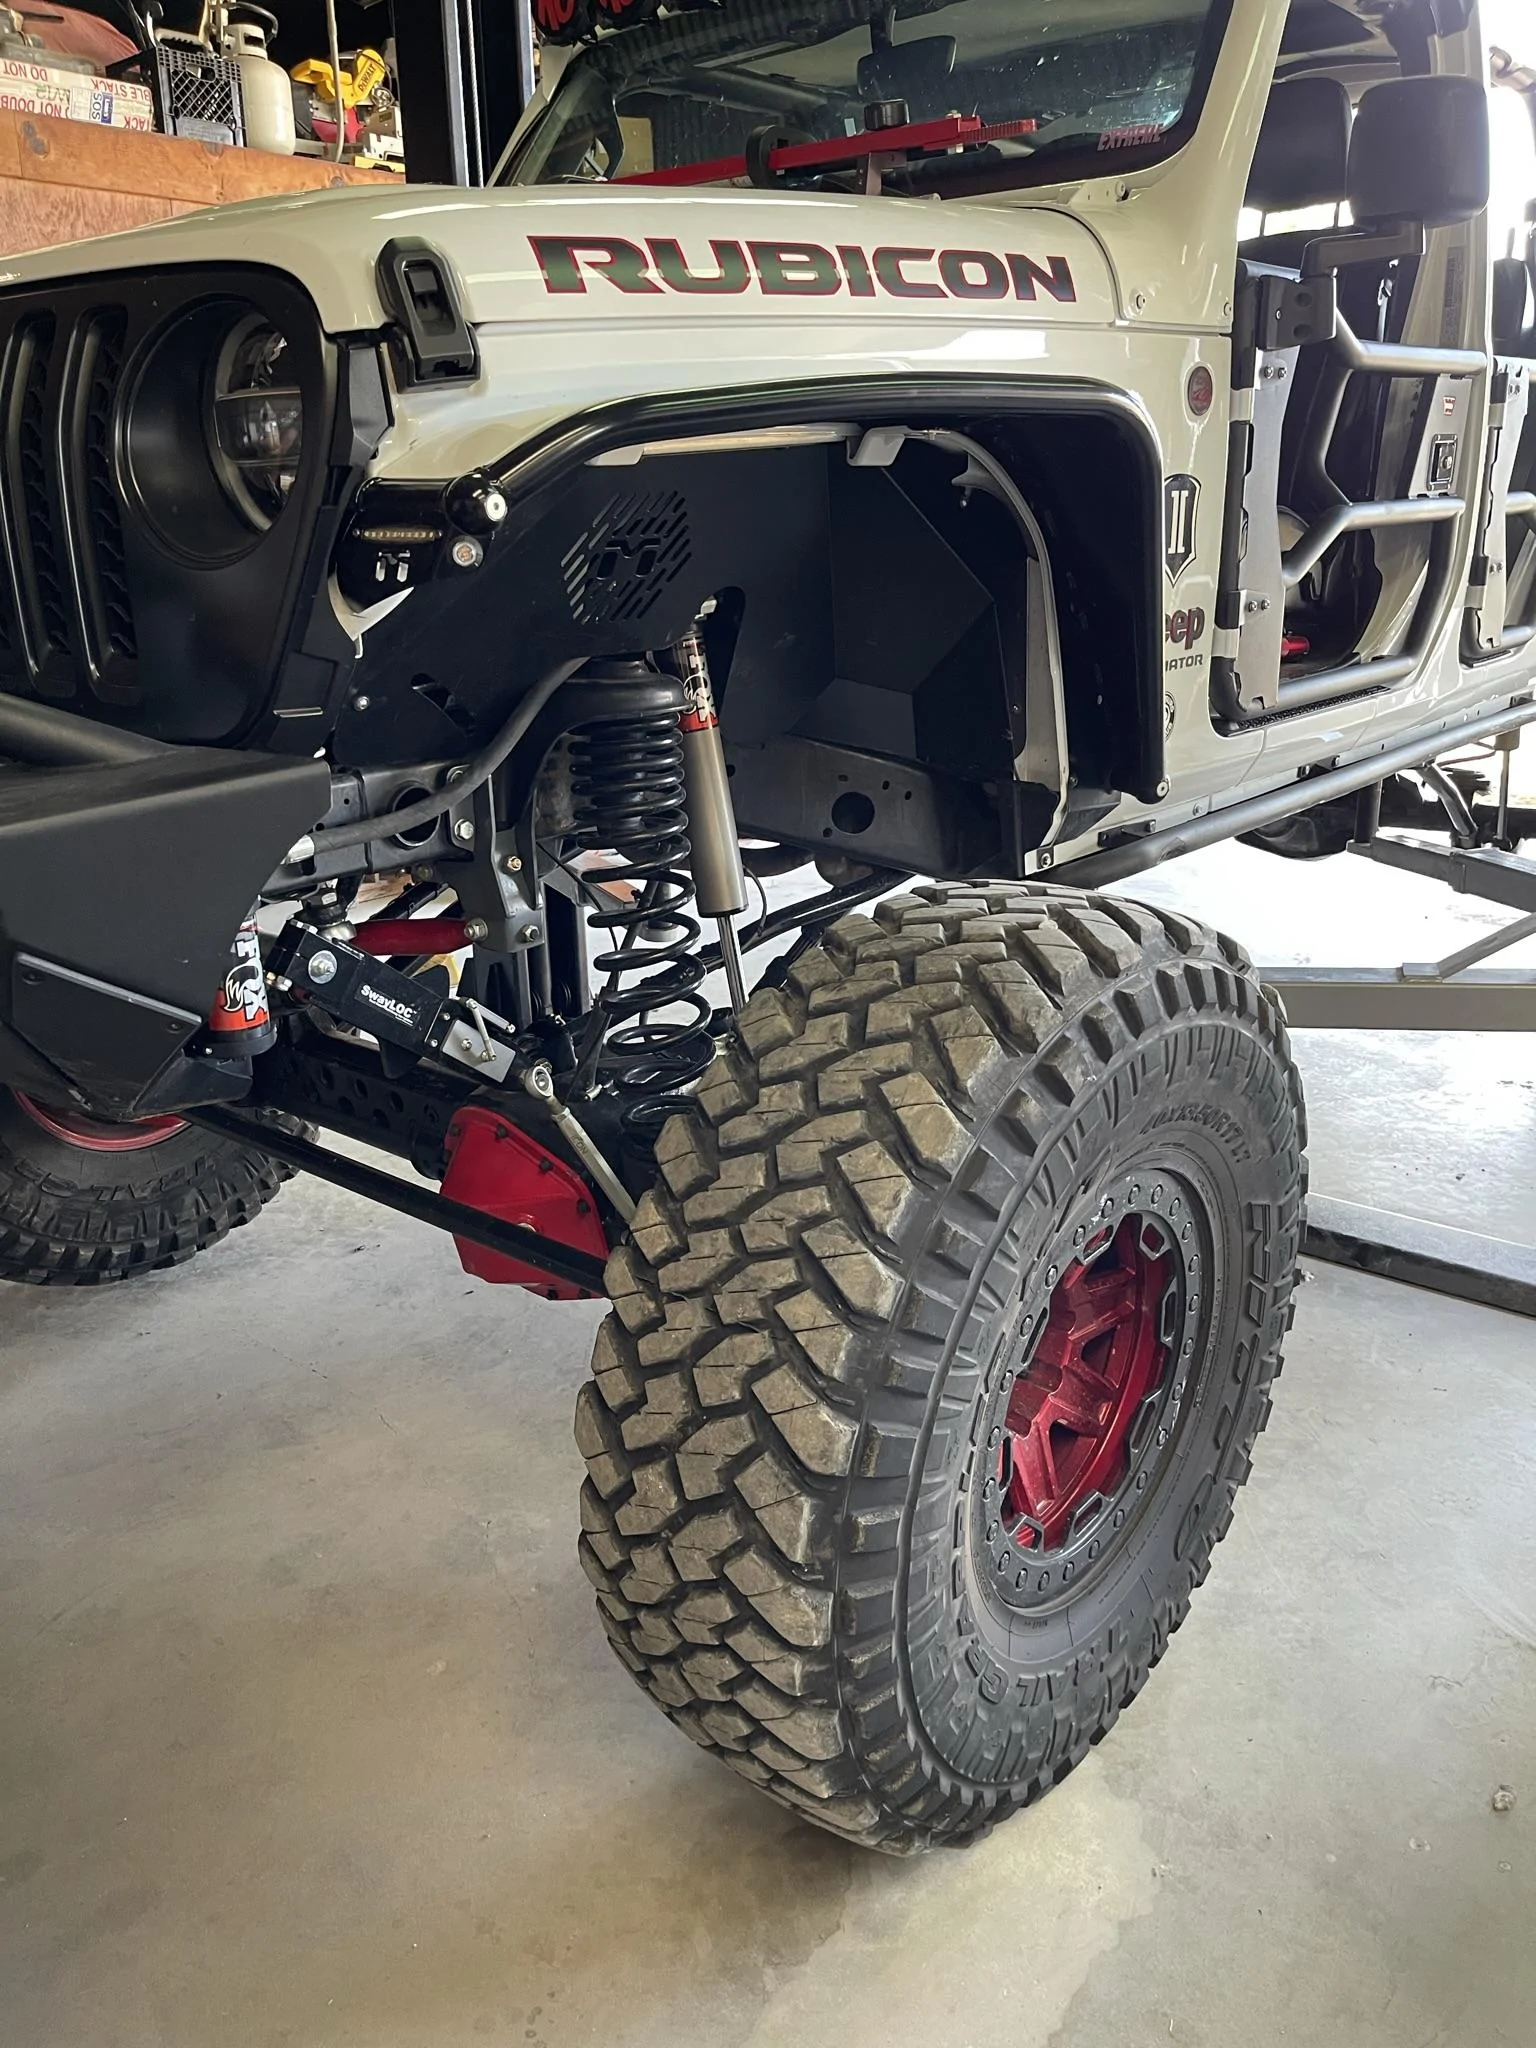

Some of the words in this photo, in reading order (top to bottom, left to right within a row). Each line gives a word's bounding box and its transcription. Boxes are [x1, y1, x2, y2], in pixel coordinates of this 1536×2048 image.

[3, 60, 28, 78] NOT
[30, 66, 48, 81] DO
[358, 63, 375, 92] DEWALT
[91, 79, 128, 96] STACK
[527, 236, 1076, 302] RUBICON
[361, 984, 414, 1019] SwayLOC
